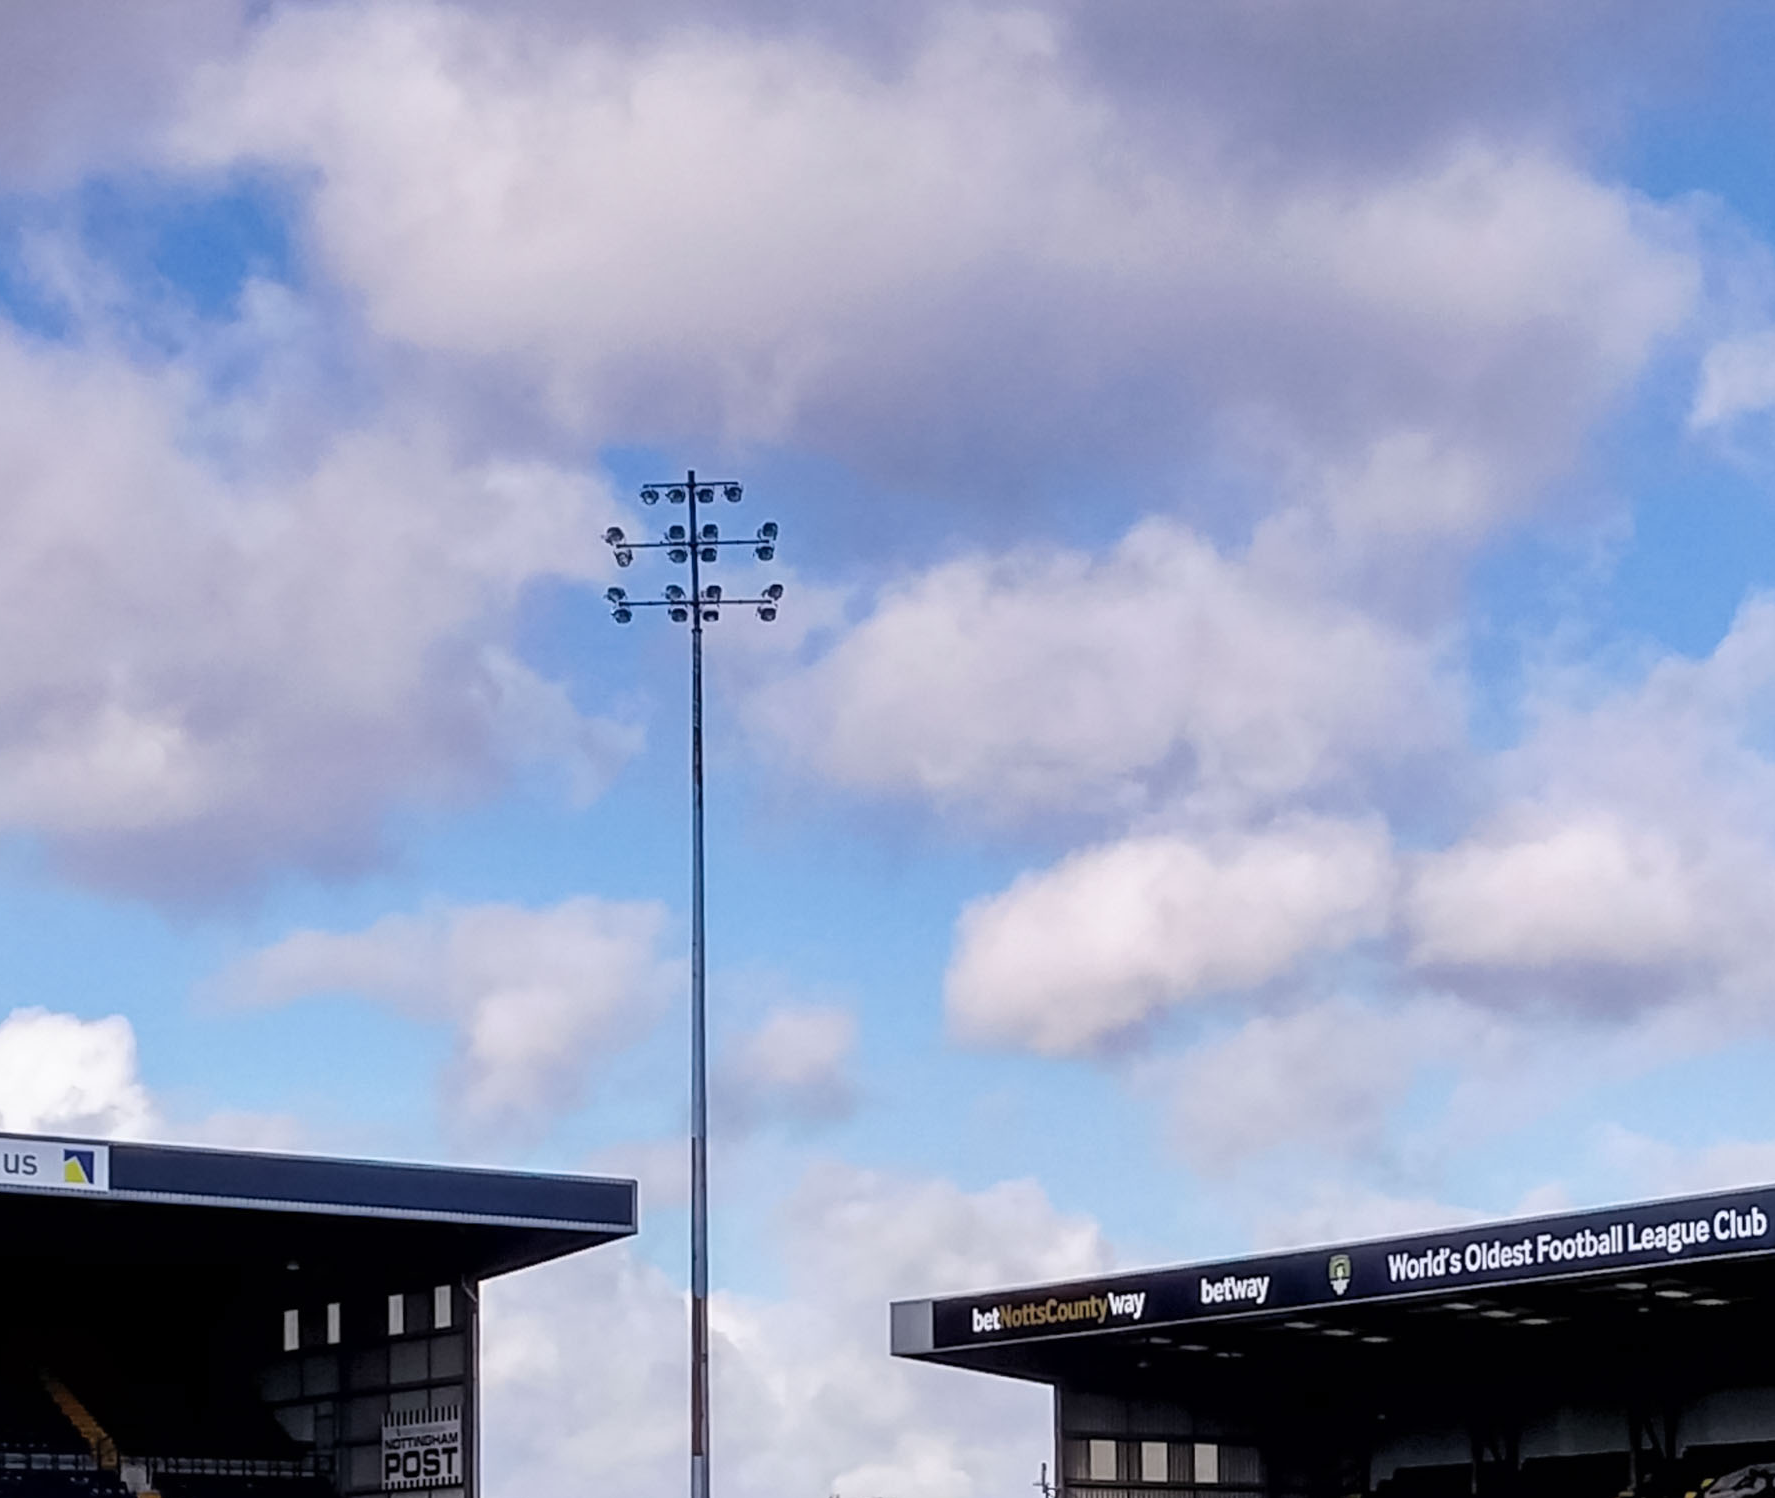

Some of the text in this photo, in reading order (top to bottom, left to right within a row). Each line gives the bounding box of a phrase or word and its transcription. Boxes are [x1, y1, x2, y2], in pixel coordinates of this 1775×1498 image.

[3, 1152, 38, 1177] us
[1387, 1207, 1768, 1283] World's Oldest Football League Club
[1200, 1271, 1270, 1309] betway
[385, 1432, 459, 1450] NOTTINGHAM
[385, 1446, 459, 1480] POST
